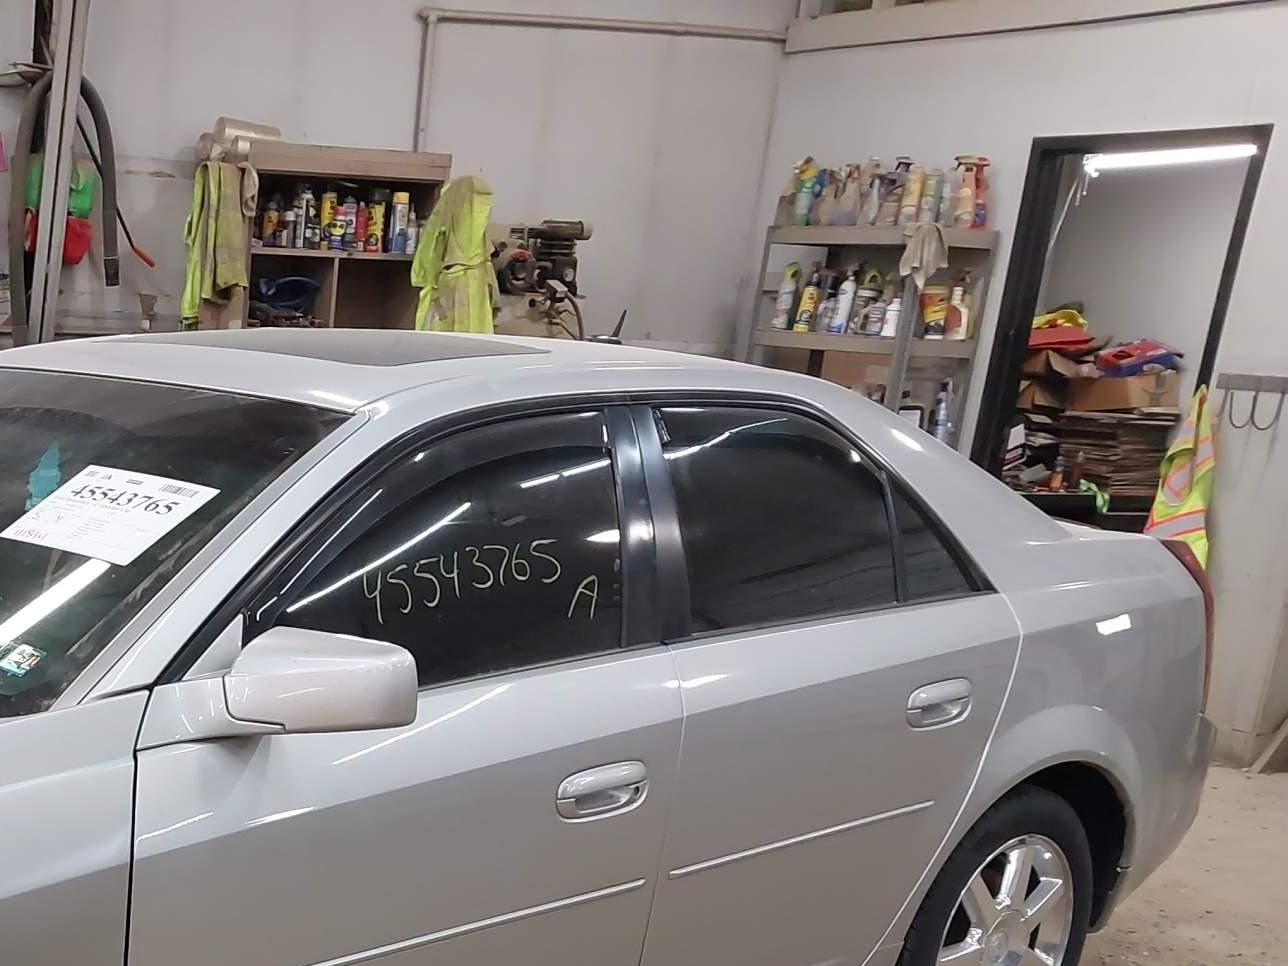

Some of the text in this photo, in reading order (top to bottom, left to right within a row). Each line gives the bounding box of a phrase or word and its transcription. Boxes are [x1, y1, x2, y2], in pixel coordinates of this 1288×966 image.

[70, 483, 181, 517] 45543765
[362, 538, 561, 625] 45543765
[567, 574, 598, 620] A
